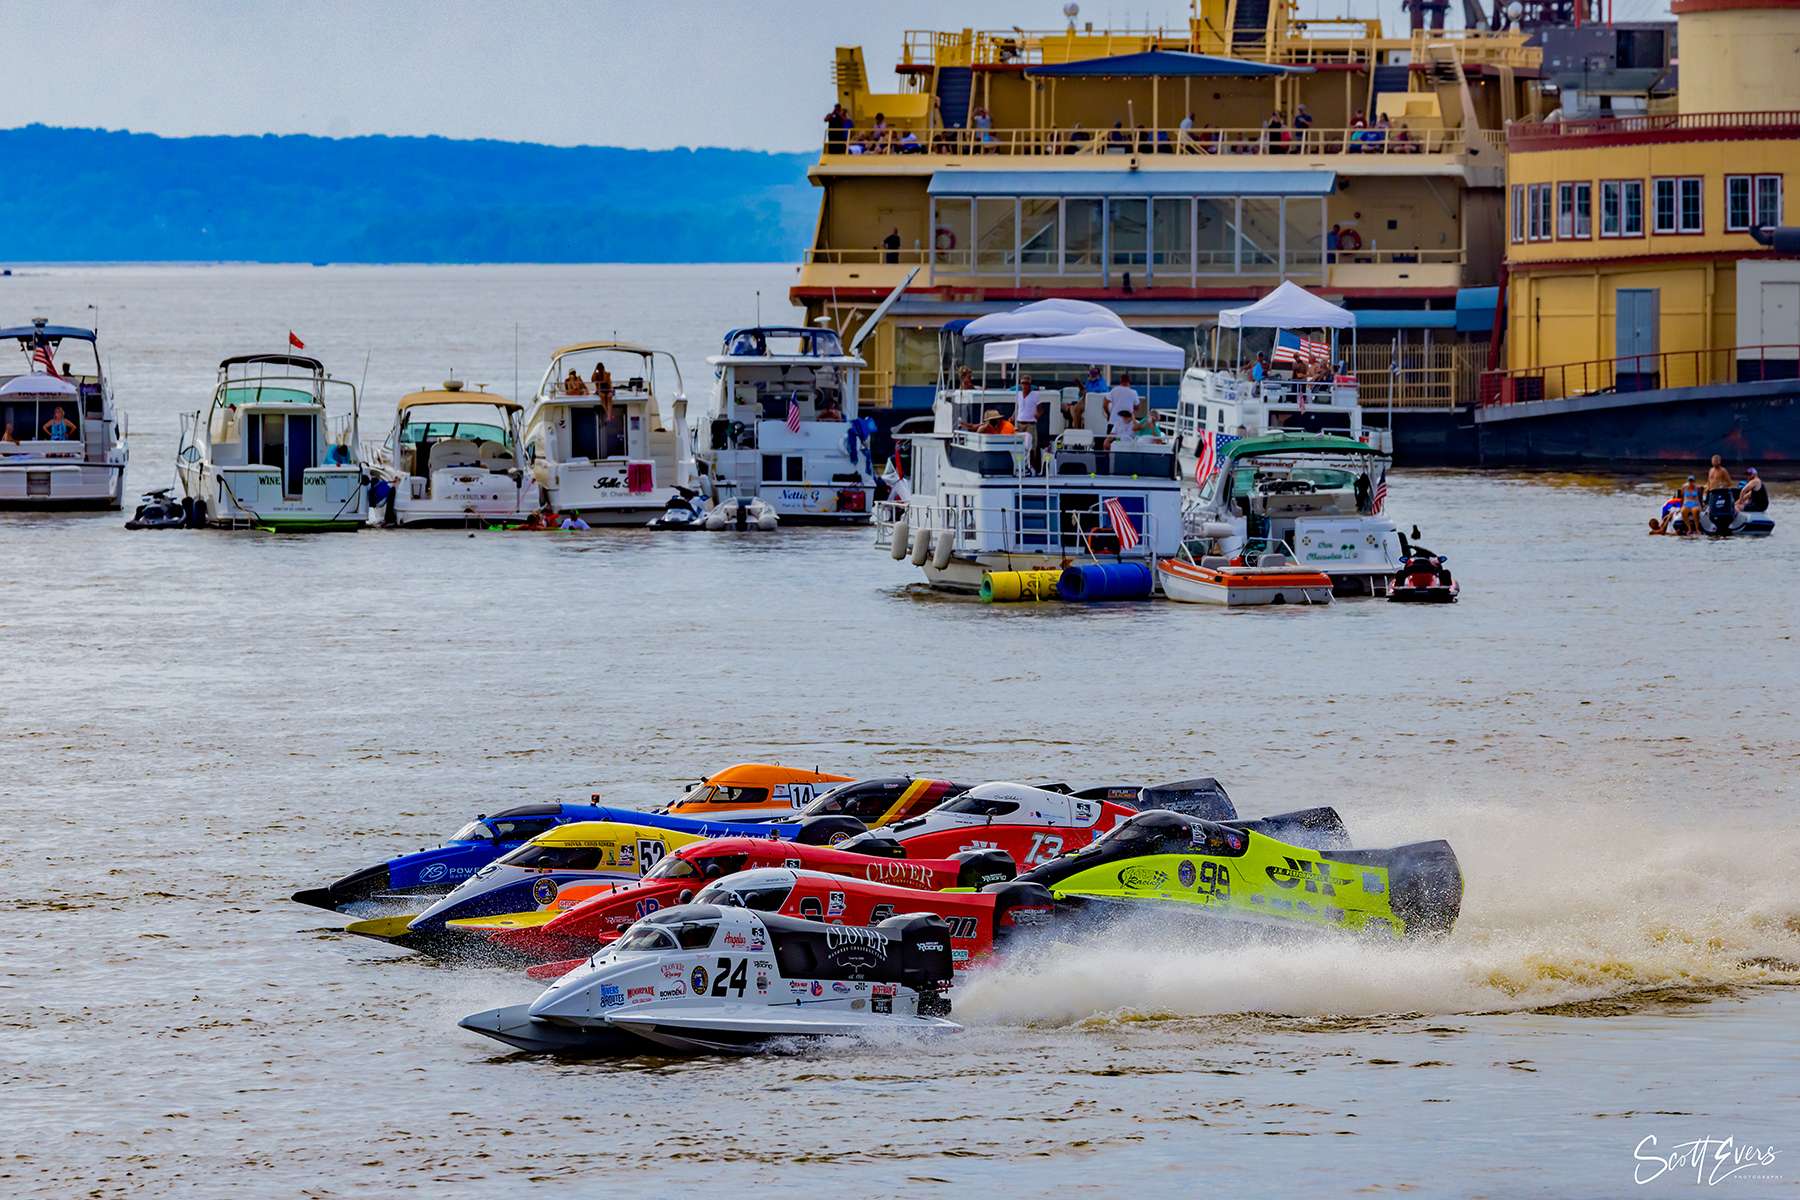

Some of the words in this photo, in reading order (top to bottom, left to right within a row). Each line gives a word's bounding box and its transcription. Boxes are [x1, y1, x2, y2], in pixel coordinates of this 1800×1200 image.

[258, 476, 281, 485] WINE
[304, 476, 326, 485] DOWN
[793, 786, 810, 808] 14
[640, 841, 665, 877] 52
[1025, 832, 1063, 864] 13
[866, 861, 933, 888] CLOVER
[827, 926, 888, 958] CLOVER
[917, 943, 943, 951] Racing
[711, 958, 748, 997] 24
